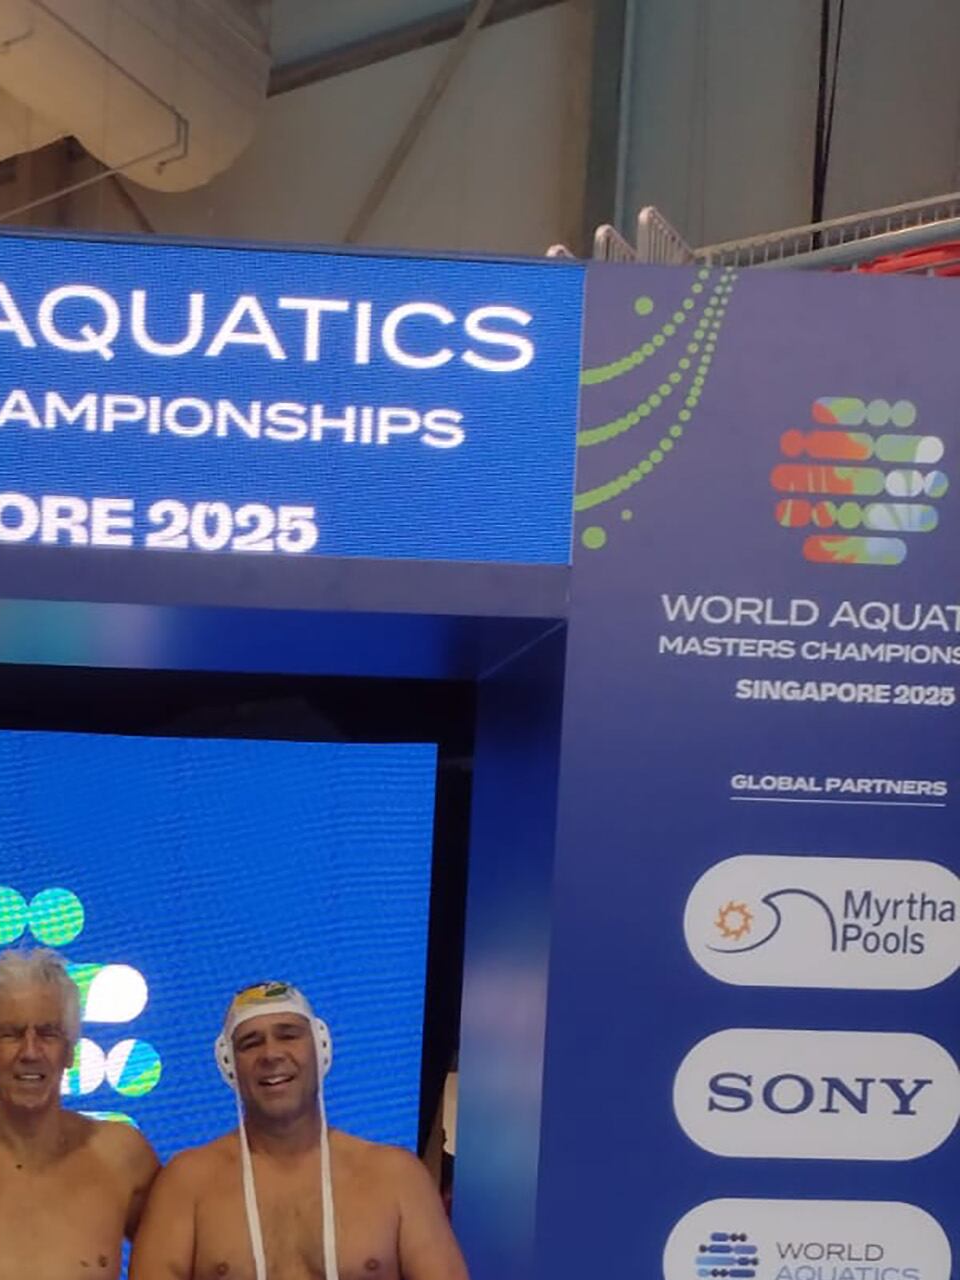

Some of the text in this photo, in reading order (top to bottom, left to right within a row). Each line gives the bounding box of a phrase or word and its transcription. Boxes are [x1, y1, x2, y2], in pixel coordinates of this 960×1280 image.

[144, 498, 319, 555] 2025
[661, 593, 821, 627] WORLD
[658, 635, 796, 660] MASTERS
[735, 678, 956, 706] SINGAPORE 2025
[730, 774, 948, 797] GLOBAL PARTNERS
[843, 889, 957, 927] Myrtha
[841, 923, 926, 955] Pools
[707, 1072, 934, 1116] SONY
[776, 1241, 885, 1263] WORLD
